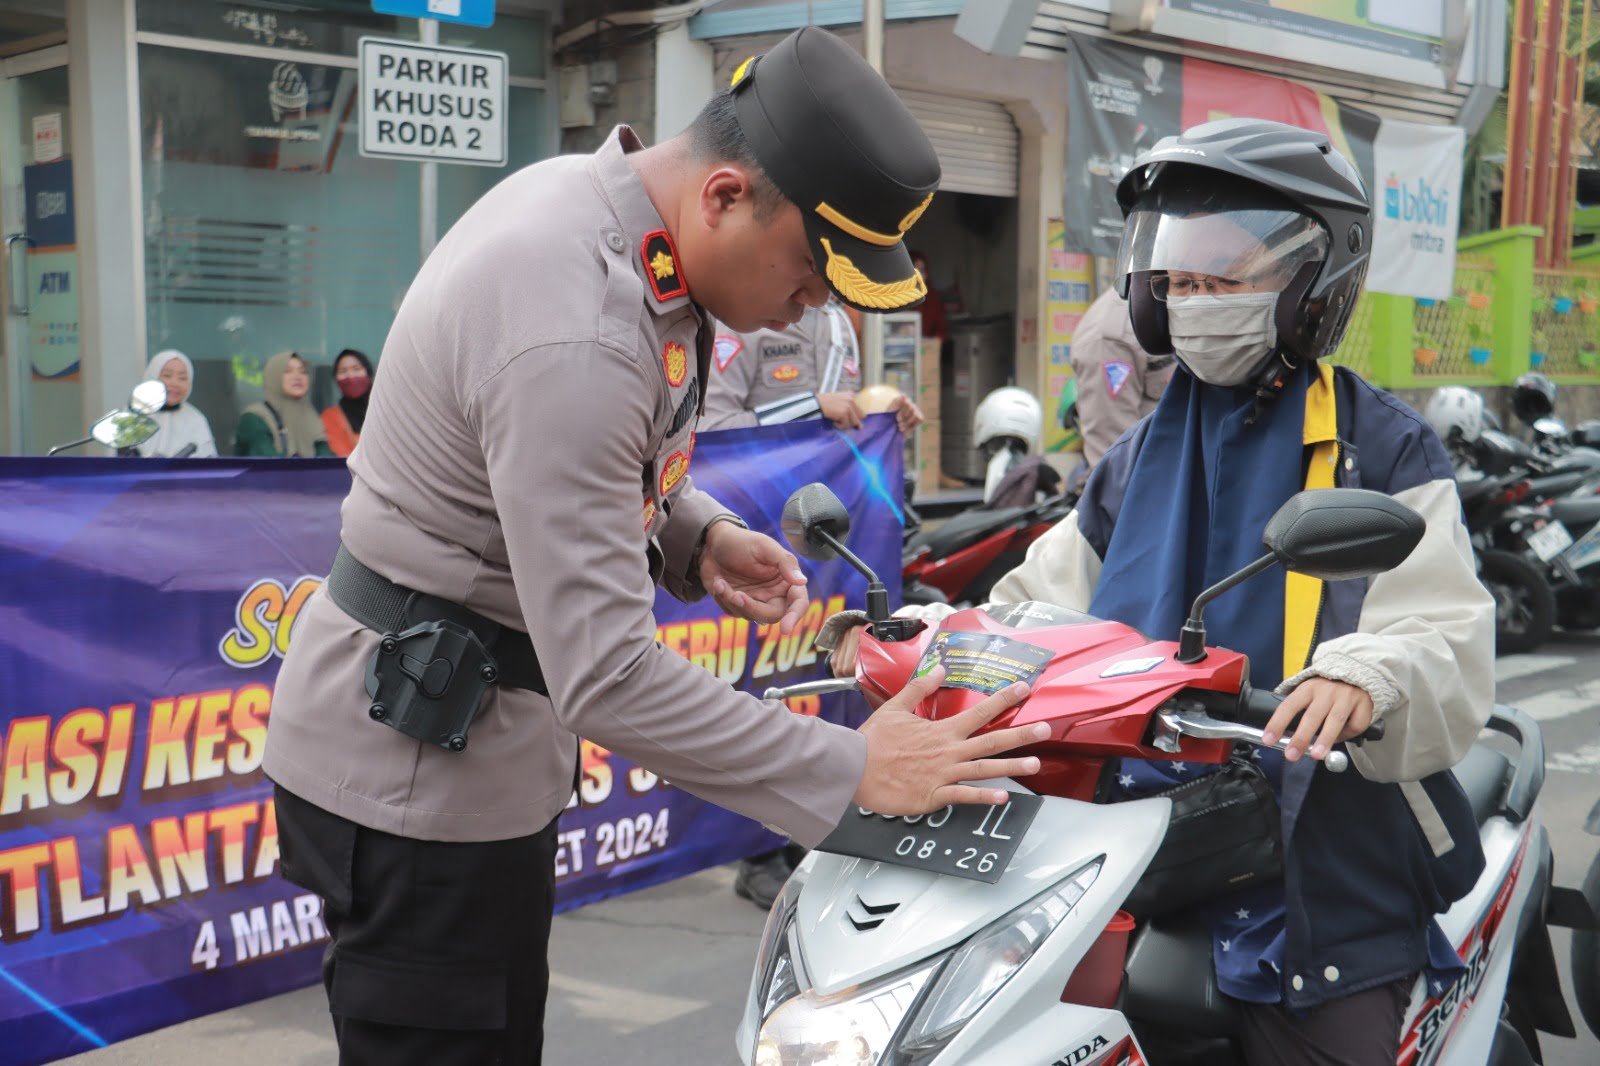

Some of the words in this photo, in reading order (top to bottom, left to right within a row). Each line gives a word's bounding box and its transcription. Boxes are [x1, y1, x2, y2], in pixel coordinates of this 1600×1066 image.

[378, 54, 489, 89] PARKIR
[373, 88, 494, 121] KHUSUS
[377, 120, 457, 148] RODA
[466, 127, 482, 150] 2
[39, 271, 71, 295] ATM
[0, 702, 136, 816] ASI
[141, 682, 274, 792] KES
[656, 613, 750, 686] ERU
[0, 796, 281, 939] TLANTA
[191, 919, 221, 971] 4
[230, 892, 331, 962] MAR
[595, 807, 670, 867] 2024
